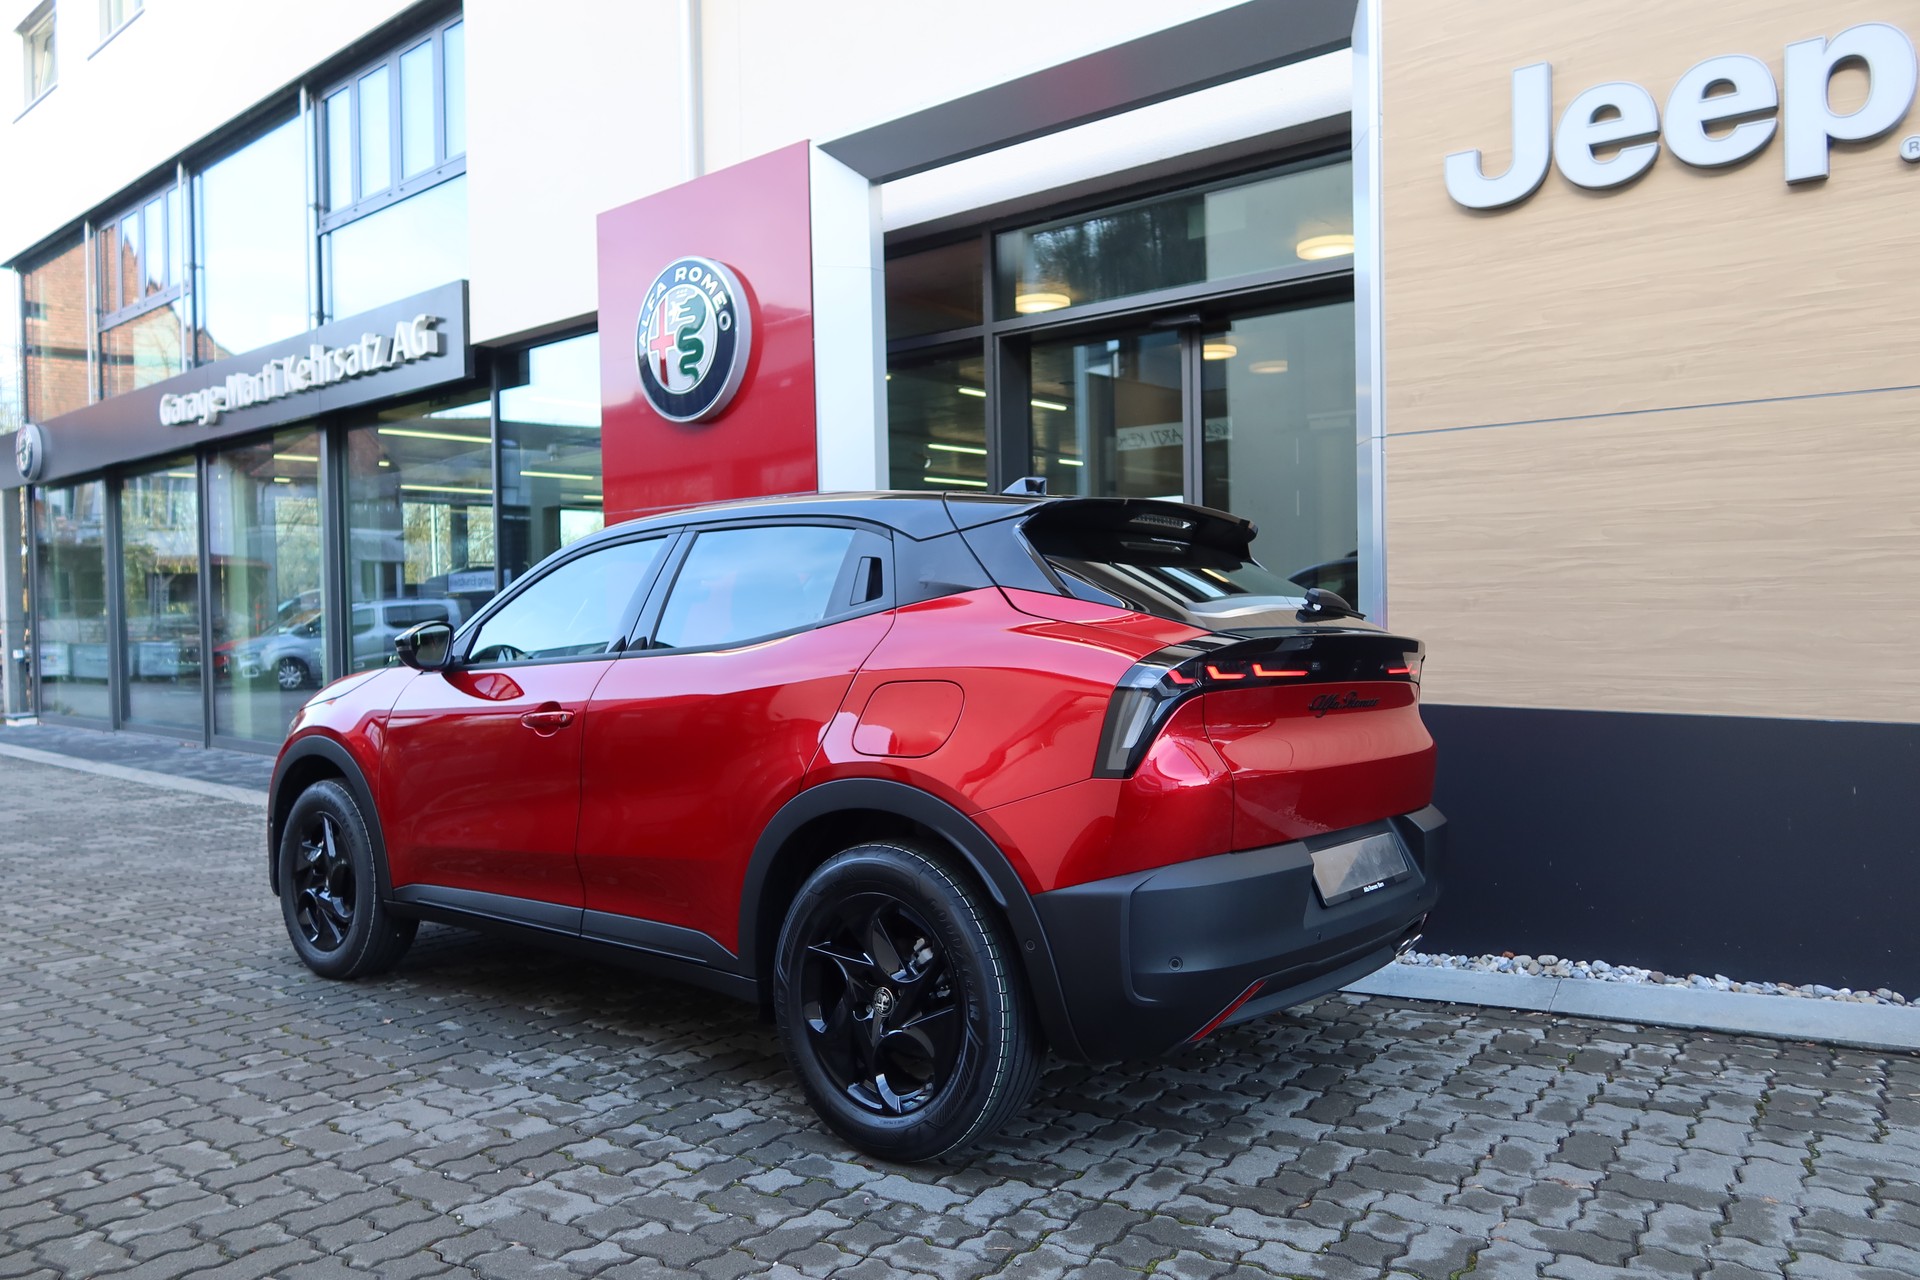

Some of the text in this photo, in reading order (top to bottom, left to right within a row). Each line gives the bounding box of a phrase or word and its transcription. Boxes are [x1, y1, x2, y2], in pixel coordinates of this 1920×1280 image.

[1444, 22, 1918, 210] Jeep
[638, 266, 732, 348] ALFA ROMEO
[159, 314, 438, 426] Garage Marti Kehrsatz AG
